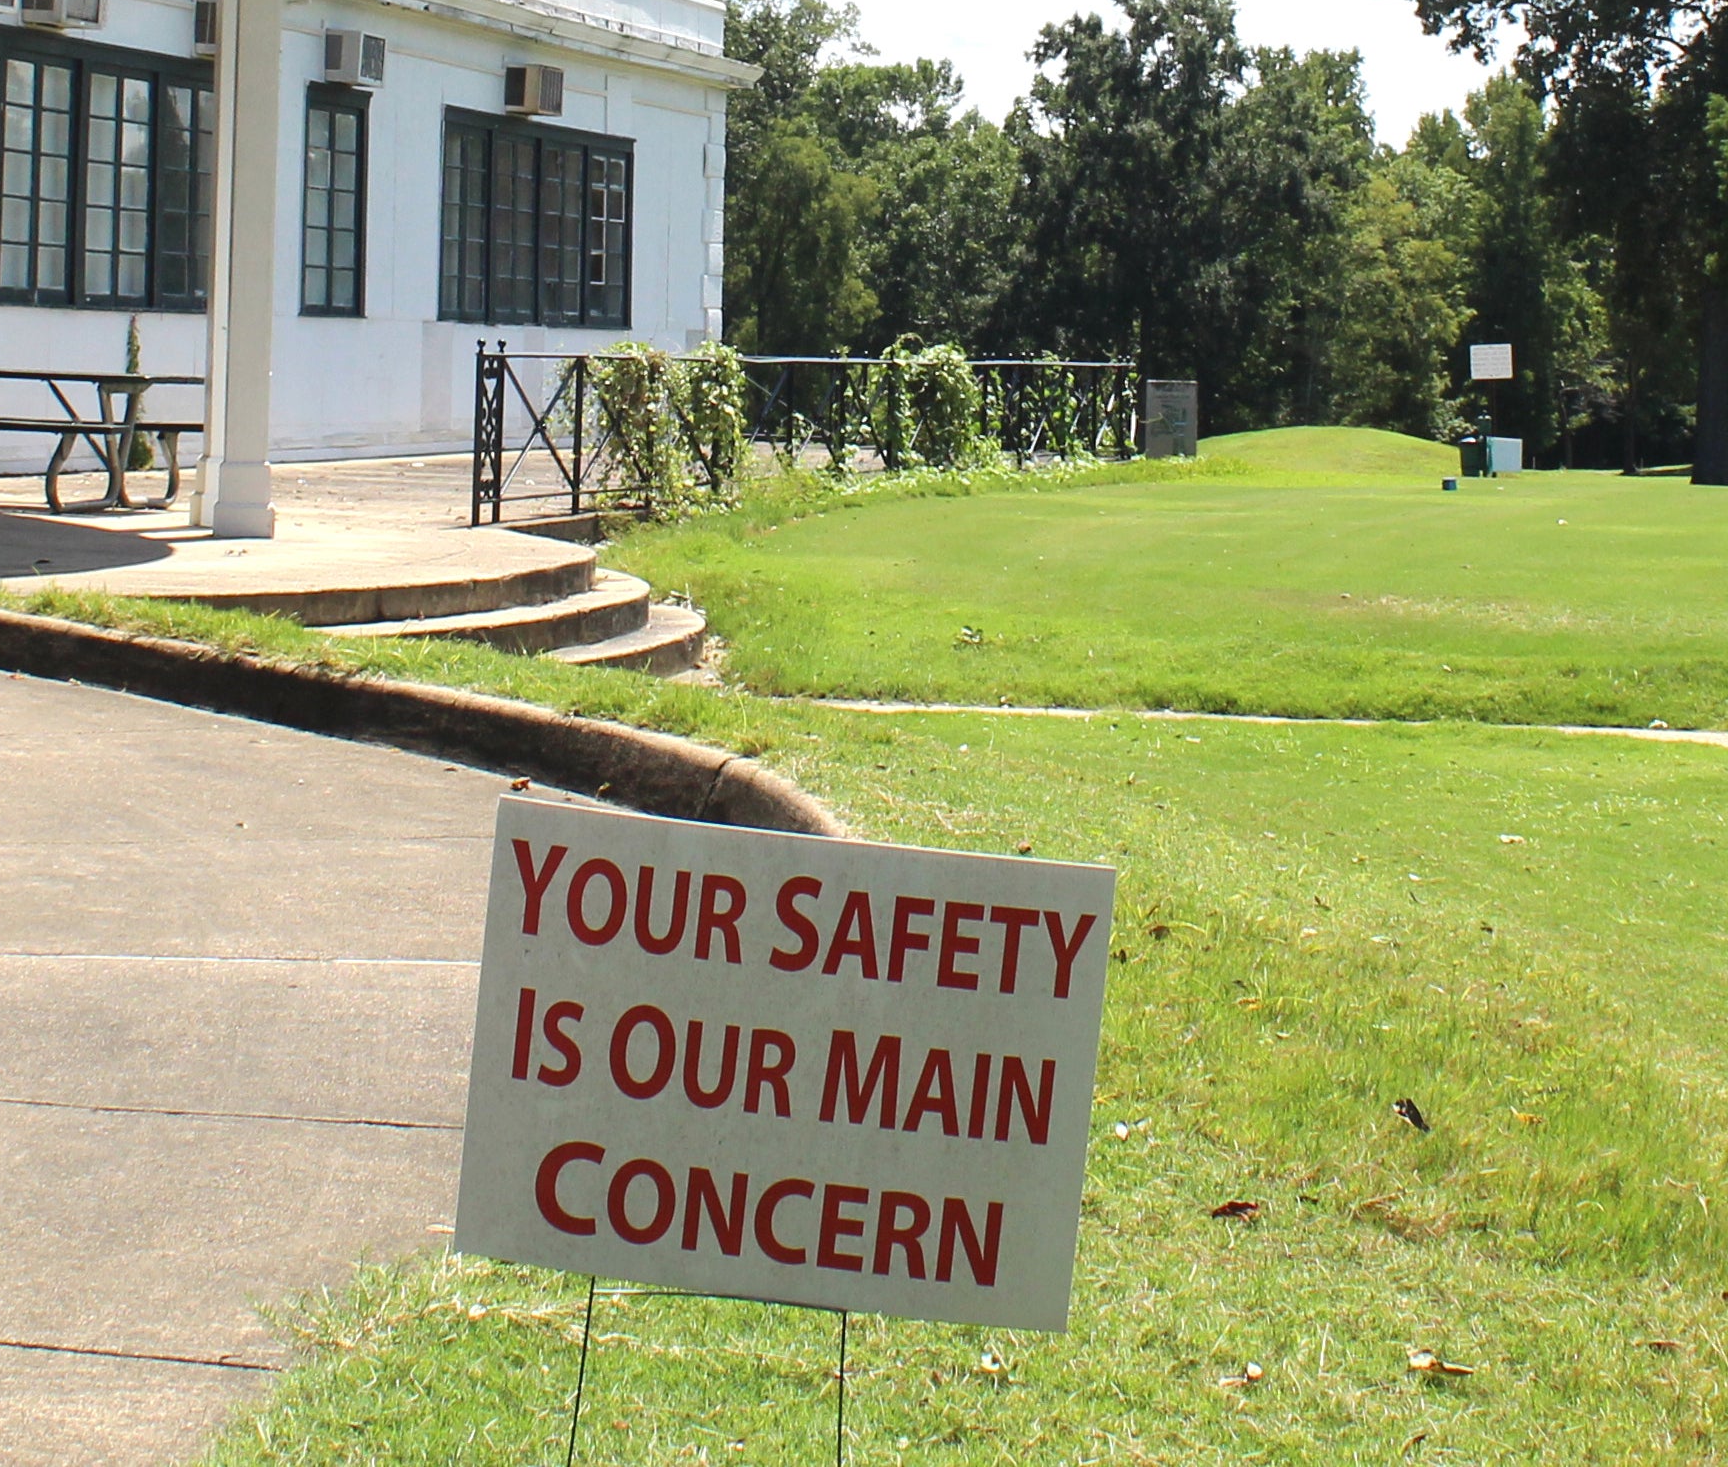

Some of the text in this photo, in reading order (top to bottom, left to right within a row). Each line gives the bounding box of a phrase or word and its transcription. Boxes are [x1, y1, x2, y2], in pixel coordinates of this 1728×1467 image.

[511, 838, 1097, 999] YOUR SAFETY
[511, 987, 1056, 1145] IS OUR MAIN
[535, 1141, 1004, 1287] CONCERN
